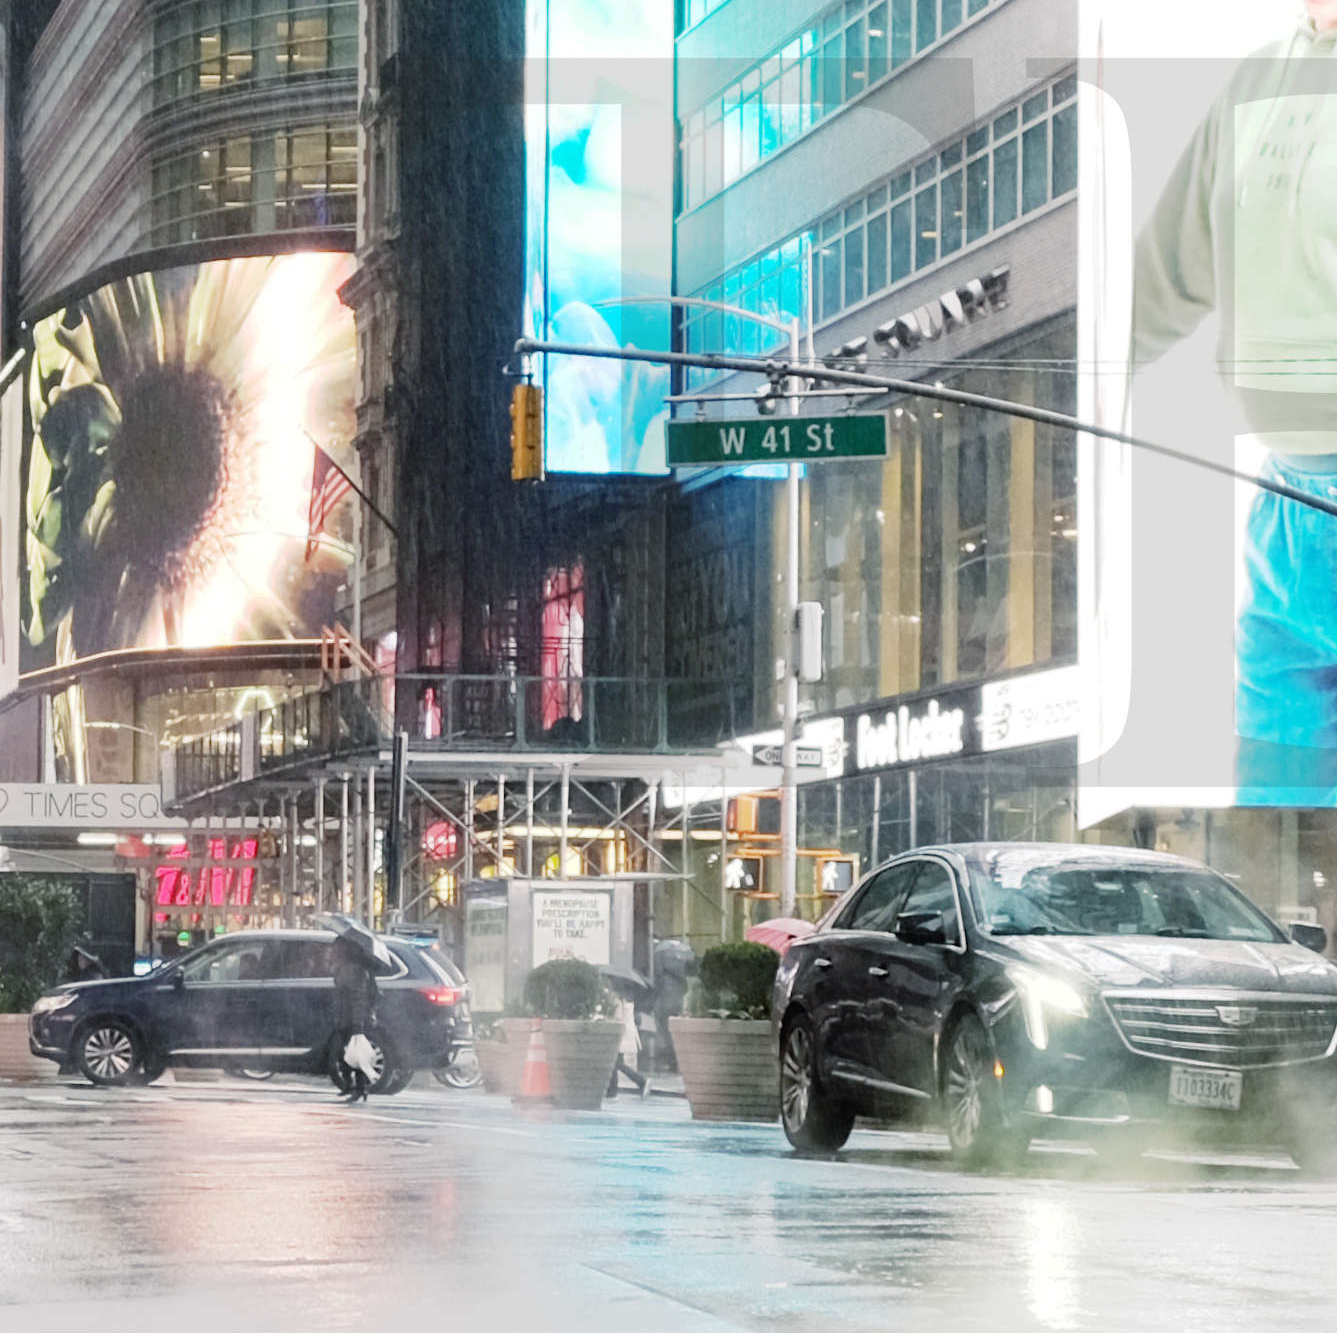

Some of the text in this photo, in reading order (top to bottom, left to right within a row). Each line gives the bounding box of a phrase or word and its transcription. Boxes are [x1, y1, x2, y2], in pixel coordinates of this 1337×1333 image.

[719, 424, 835, 455] W 41 St
[899, 699, 965, 761] Locker
[24, 791, 108, 819] TIMES
[120, 793, 162, 820] SQ
